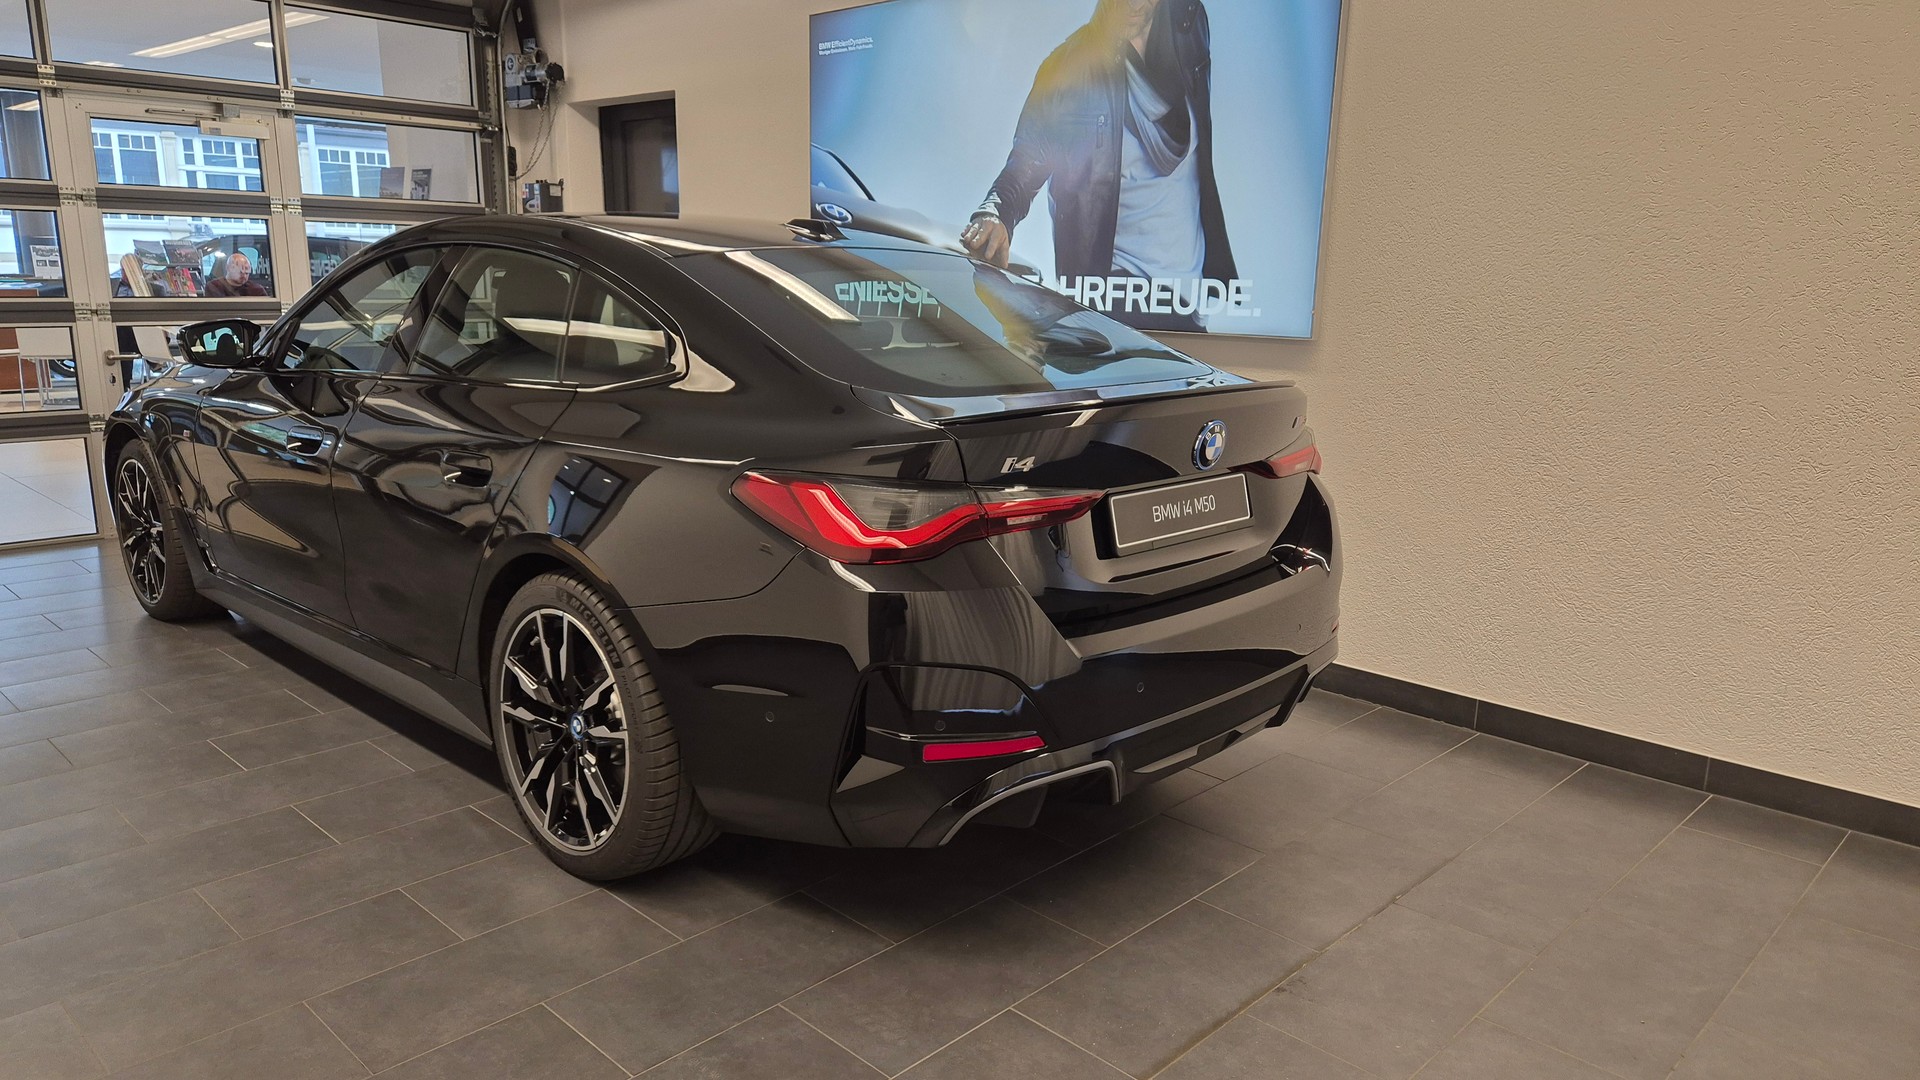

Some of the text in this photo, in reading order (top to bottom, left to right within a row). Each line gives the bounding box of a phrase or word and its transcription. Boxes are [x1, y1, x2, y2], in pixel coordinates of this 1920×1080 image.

[818, 41, 831, 50] BMW
[1021, 274, 1262, 317] HRFREUDE.
[1000, 456, 1036, 474] i4
[1152, 494, 1217, 523] BMW i4 M50
[569, 597, 619, 664] MICHELIN
